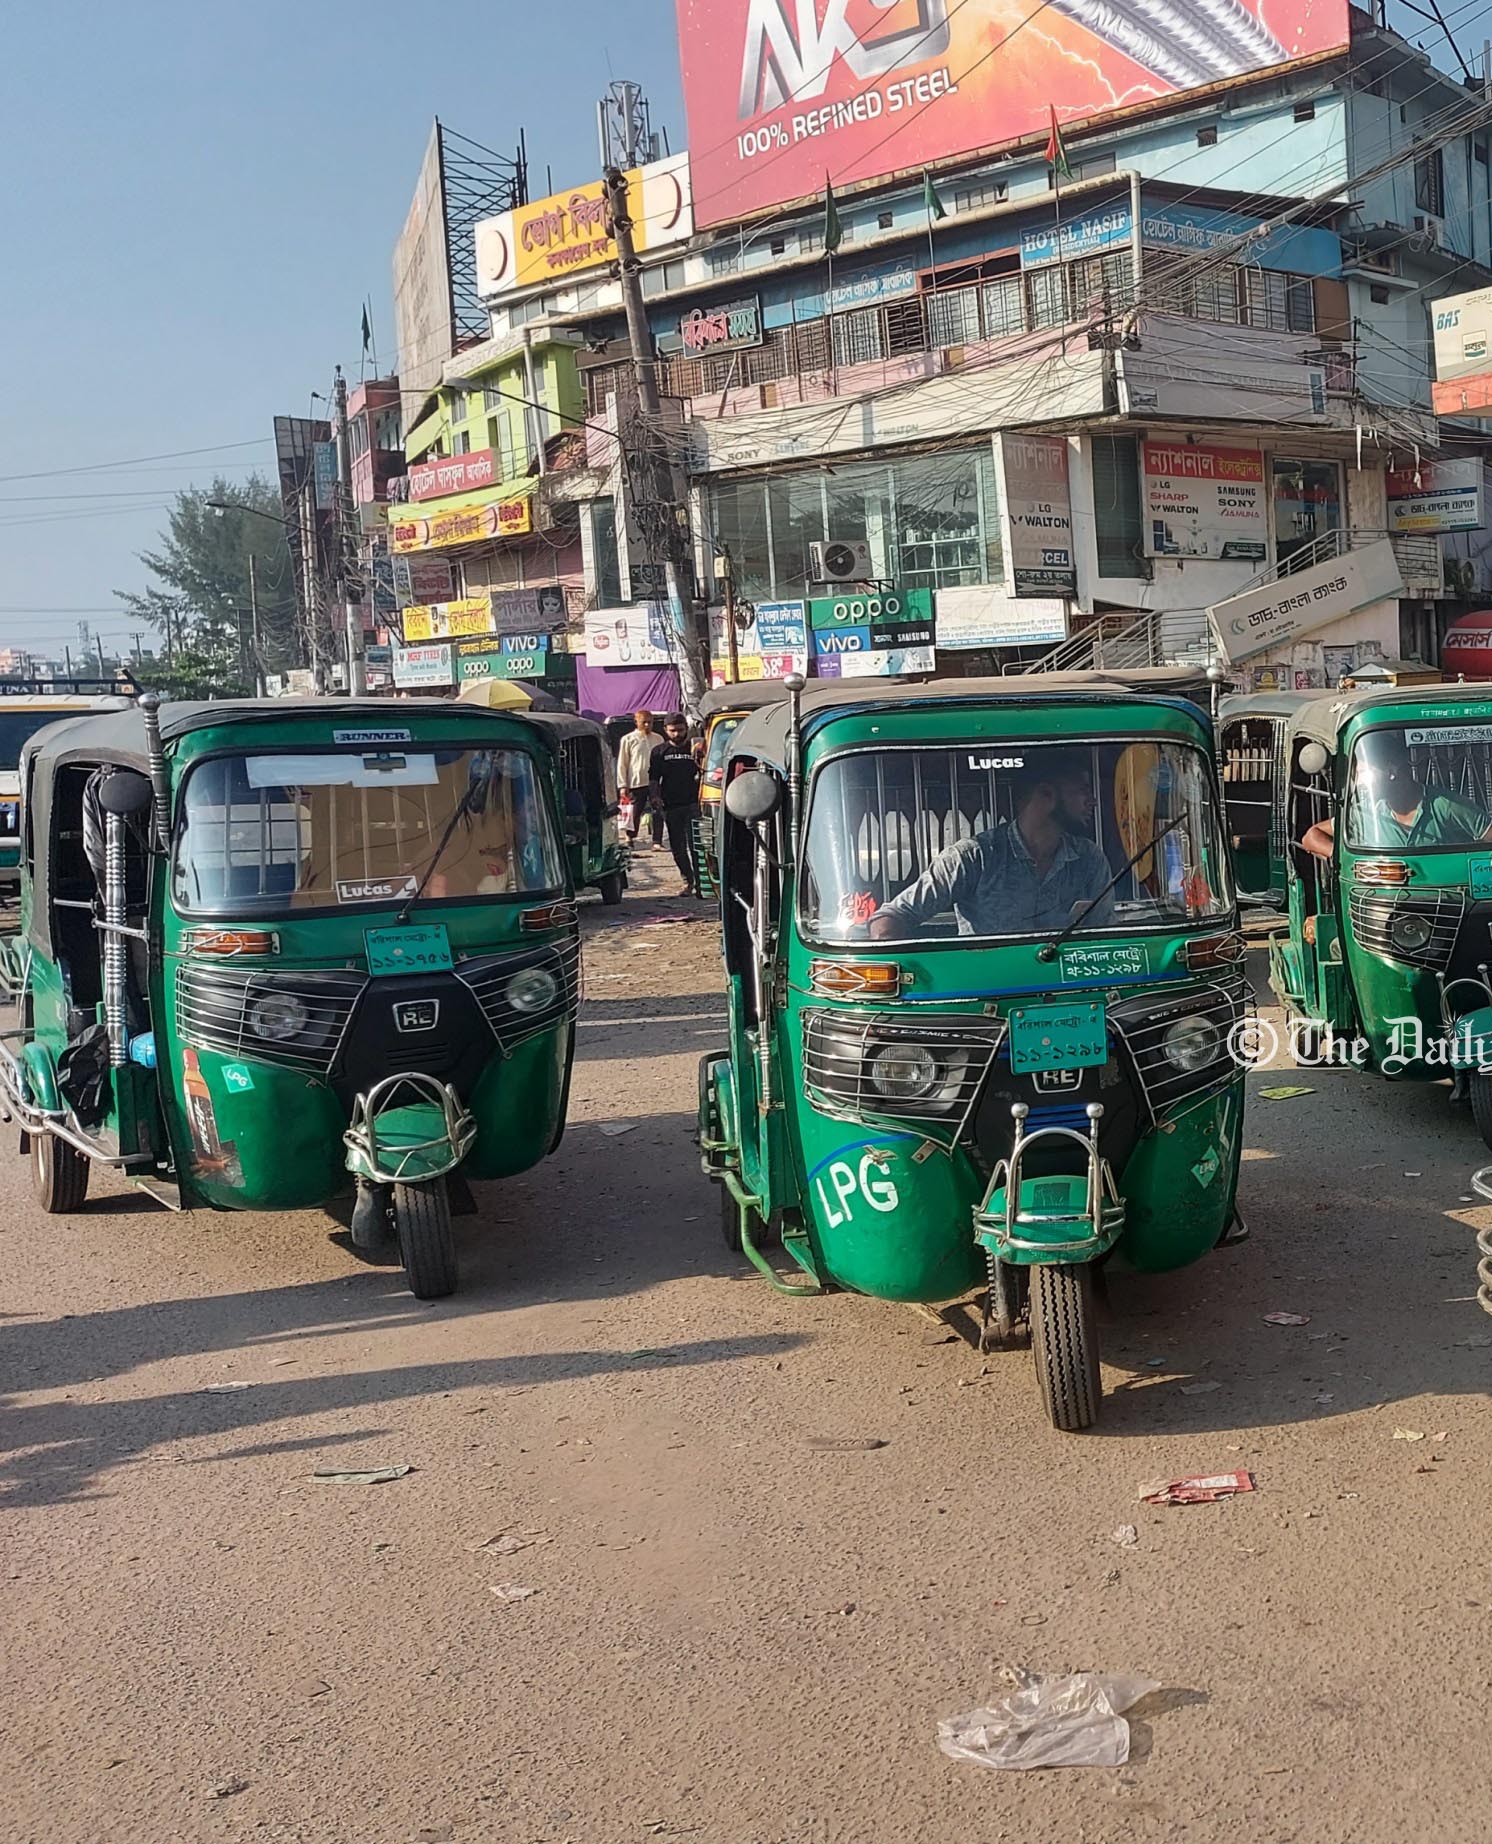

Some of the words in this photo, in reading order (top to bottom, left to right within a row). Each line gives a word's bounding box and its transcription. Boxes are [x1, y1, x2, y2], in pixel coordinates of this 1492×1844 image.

[737, 125, 789, 160] 100%
[791, 91, 884, 144] REFINED
[886, 66, 958, 112] STEEL
[1023, 225, 1077, 252] HOTEL
[1080, 210, 1128, 236] NASIF
[1437, 309, 1461, 332] BAS
[727, 449, 761, 462] SONY
[1148, 448, 1214, 477] ন্যাশনাল
[1159, 480, 1171, 489] LG
[1217, 486, 1256, 497] SAMSUNG
[1150, 491, 1189, 501] SHARP
[1218, 498, 1256, 508] SONY
[1039, 504, 1052, 513] LG
[1162, 504, 1199, 515] WALTON
[1026, 515, 1069, 528] WALTON
[1312, 576, 1348, 600] ব্যাংক
[833, 597, 900, 623] oppo
[819, 633, 861, 653] vivo
[897, 631, 930, 643] SAMSUNG
[1446, 630, 1492, 648] মেসার্স
[341, 731, 406, 741] RUNNER
[968, 755, 1024, 770] Lucas
[341, 882, 392, 898] Lucas
[1064, 951, 1110, 964] বরিশাল
[403, 1009, 432, 1026] RE
[1016, 1041, 1104, 1063] ১১-১২৯৮
[227, 1068, 248, 1087] LPG
[1043, 1071, 1075, 1084] RE
[814, 1155, 899, 1229] LPG
